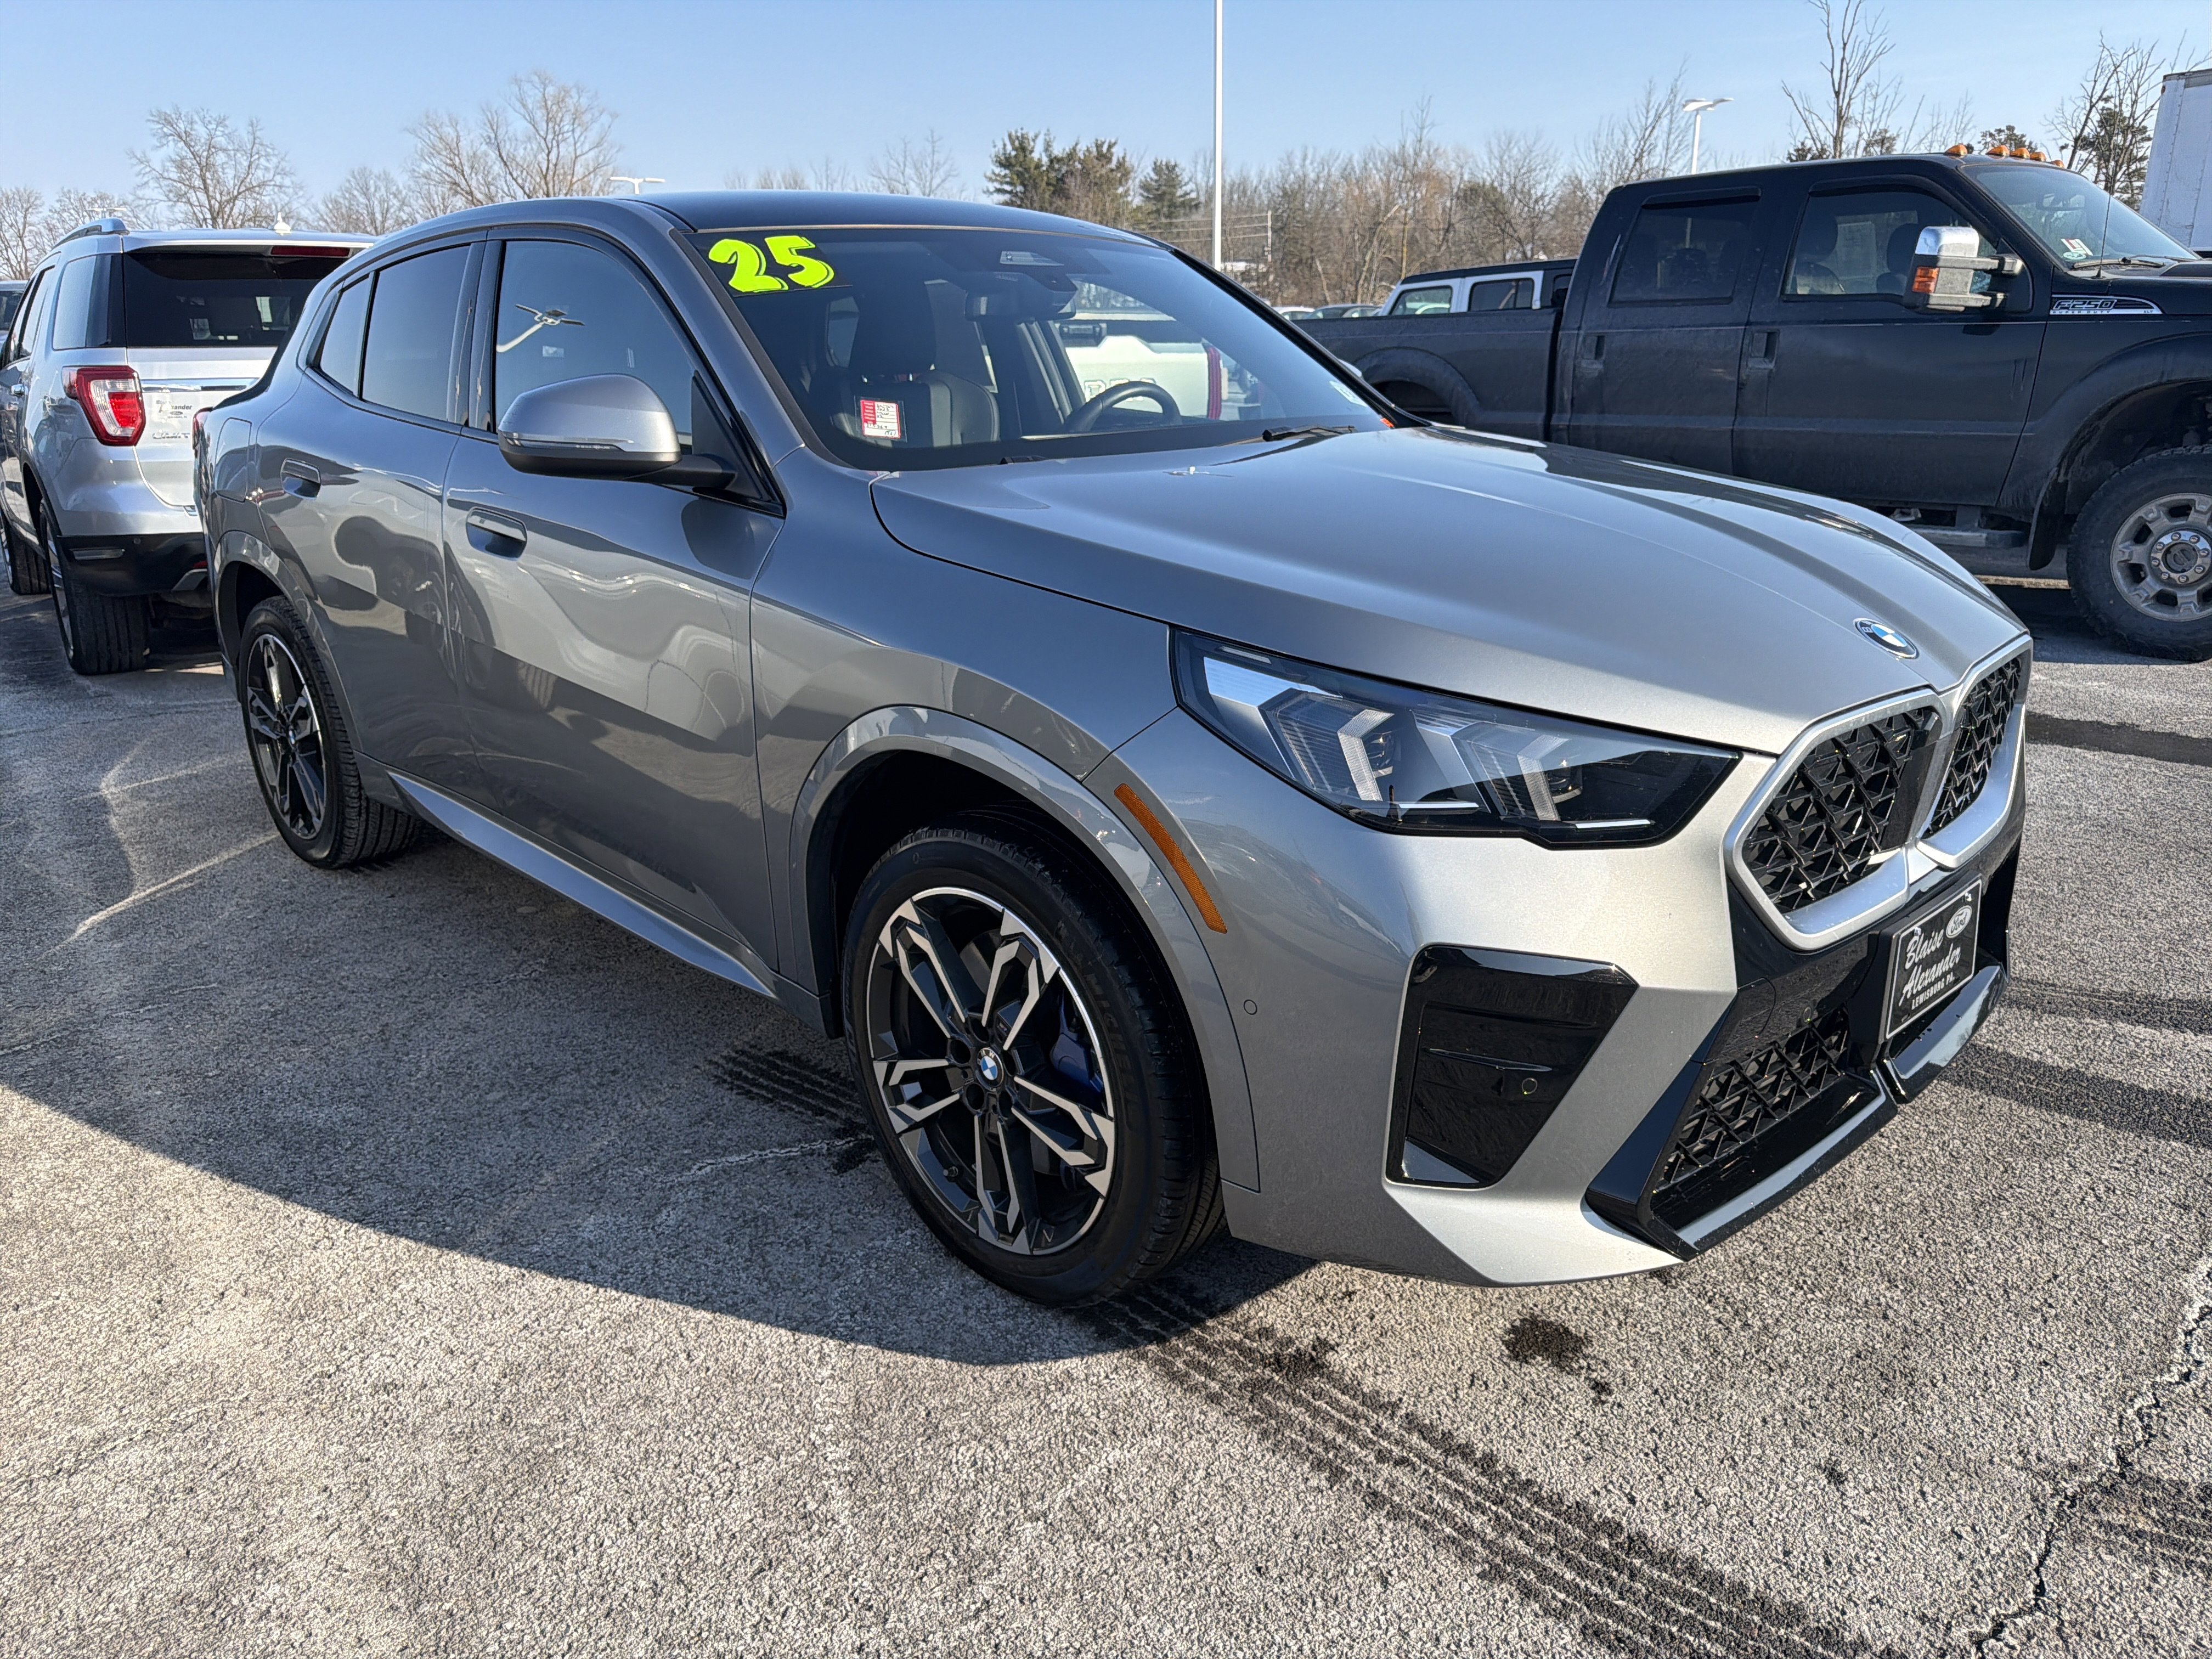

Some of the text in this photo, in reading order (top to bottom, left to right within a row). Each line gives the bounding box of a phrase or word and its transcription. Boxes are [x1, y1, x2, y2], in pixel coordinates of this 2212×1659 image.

[708, 235, 834, 292] 25
[1950, 911, 1968, 934] Ford
[1905, 928, 1944, 970] Blaise
[1899, 943, 1961, 1007] Alexander
[1911, 979, 1944, 1010] LEWISBURG
